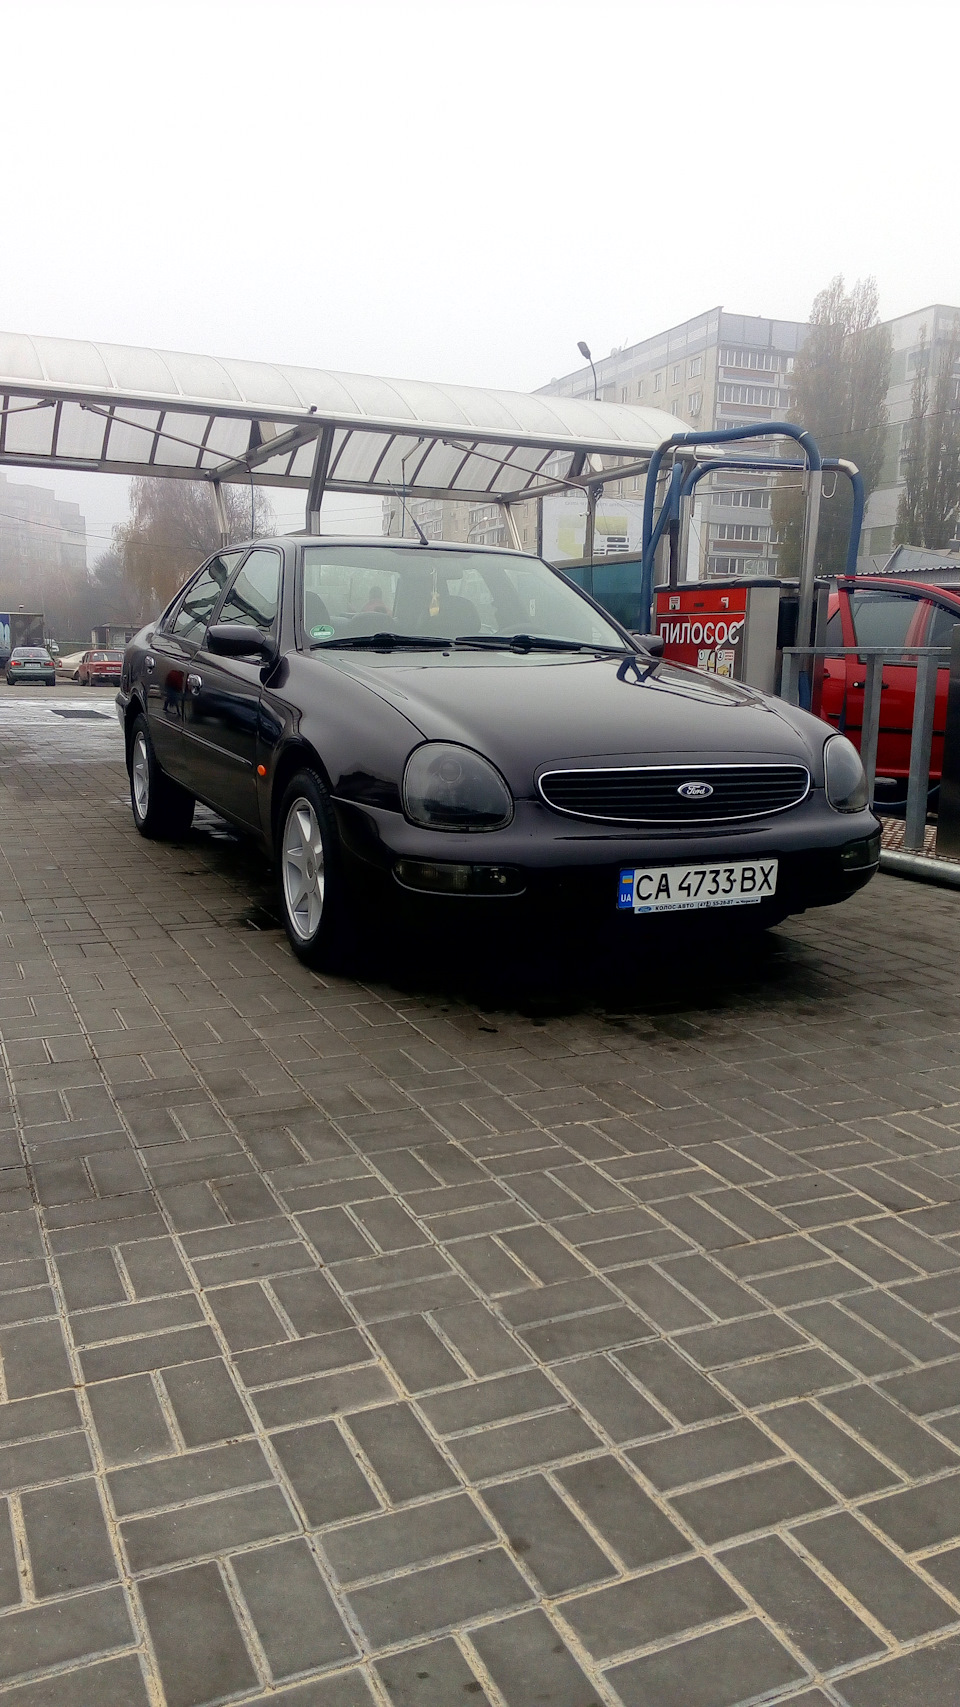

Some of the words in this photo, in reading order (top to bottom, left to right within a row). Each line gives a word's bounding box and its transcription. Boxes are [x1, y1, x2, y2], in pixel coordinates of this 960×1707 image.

[660, 621, 740, 645] ПИЛОСОС
[686, 785, 706, 795] Ford
[636, 873, 671, 901] CA
[678, 868, 735, 898] 4733
[740, 864, 775, 893] BX
[620, 893, 632, 903] UA
